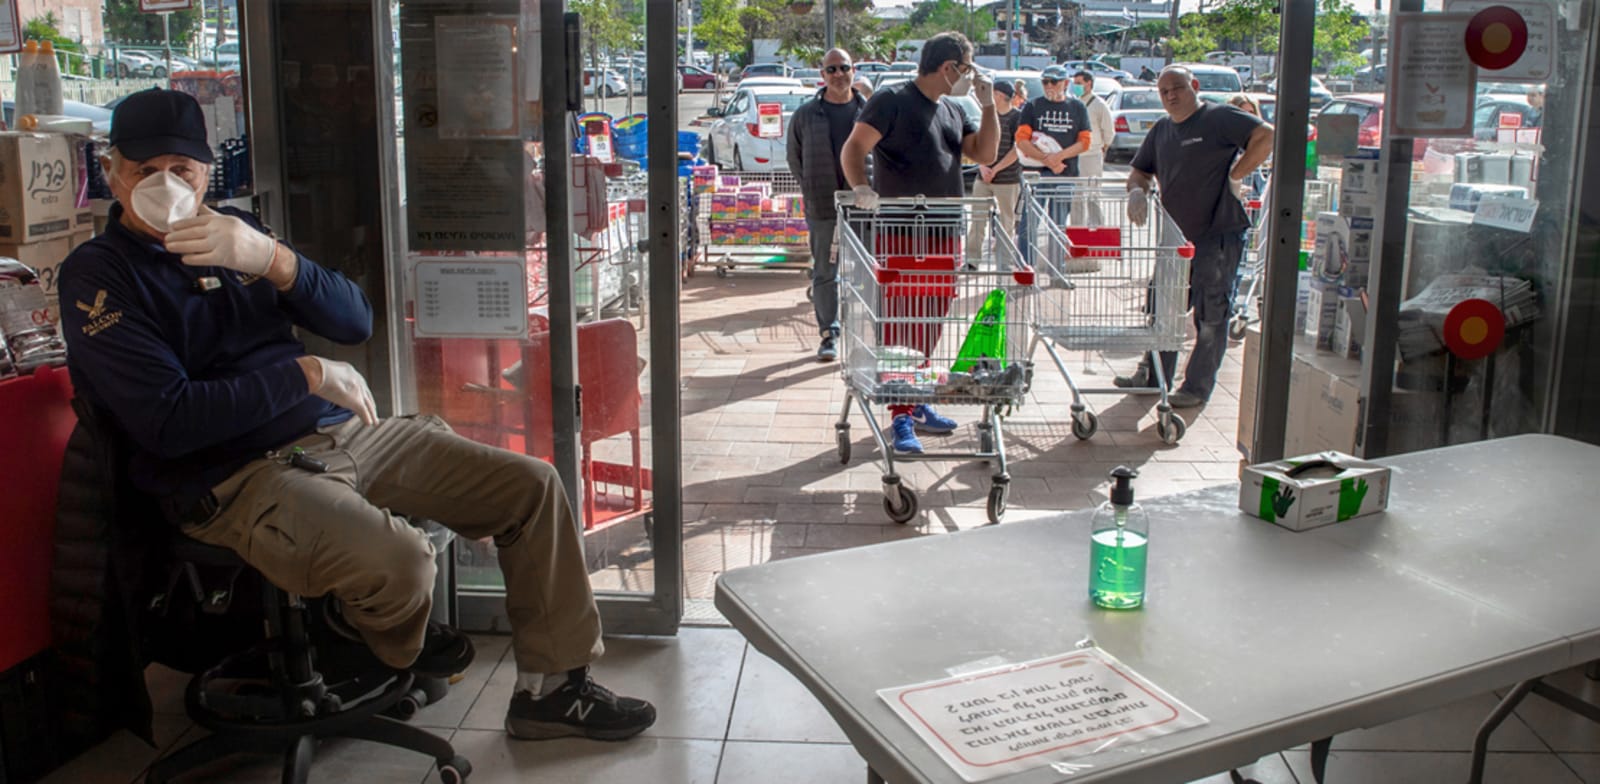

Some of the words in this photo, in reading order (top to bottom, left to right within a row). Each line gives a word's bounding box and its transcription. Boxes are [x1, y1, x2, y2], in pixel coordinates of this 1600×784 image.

[82, 311, 123, 334] FALCON
[565, 698, 595, 721] N
[944, 704, 959, 714] 2
[960, 697, 996, 709] מטר
[997, 688, 1021, 700] בין
[1023, 684, 1057, 695] אחד
[958, 707, 1010, 723] לשמור
[1012, 701, 1036, 710] על
[1036, 689, 1080, 705] מרחק
[1082, 685, 1109, 695] של
[959, 726, 990, 735] באי
[992, 710, 1054, 728] המרכול
[1054, 692, 1129, 713] מתבקשים
[964, 729, 1032, 748] בהוראת
[1033, 718, 1082, 732] משרד
[1083, 701, 1149, 720] הבריאות
[1008, 737, 1050, 752] לקוחות
[1054, 729, 1084, 741] יקרים
[1086, 721, 1112, 732] שימו
